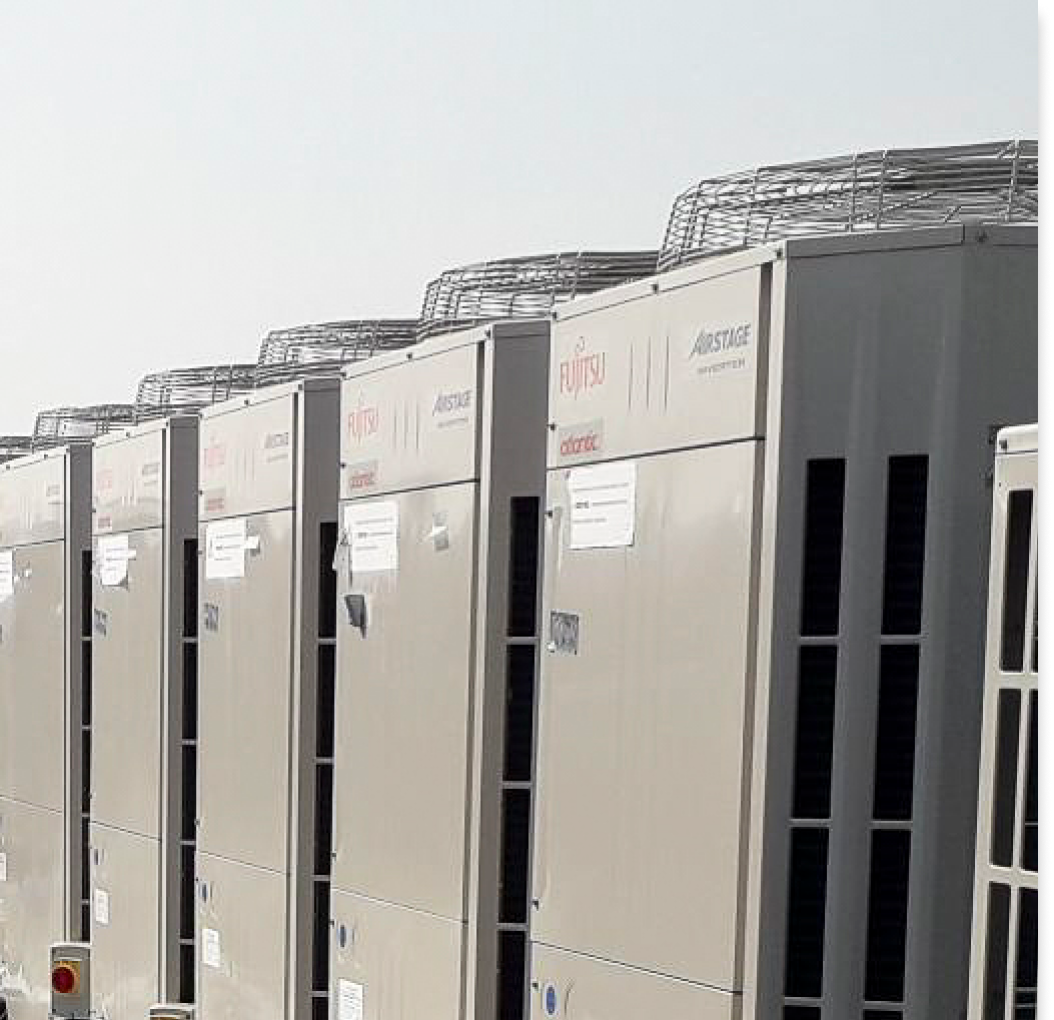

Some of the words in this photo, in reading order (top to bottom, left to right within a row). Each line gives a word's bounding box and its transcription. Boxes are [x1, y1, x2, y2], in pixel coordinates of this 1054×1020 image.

[688, 324, 751, 360] AIRSTAGE
[560, 350, 606, 400] FUJITSU
[348, 406, 379, 444] FUJITSU
